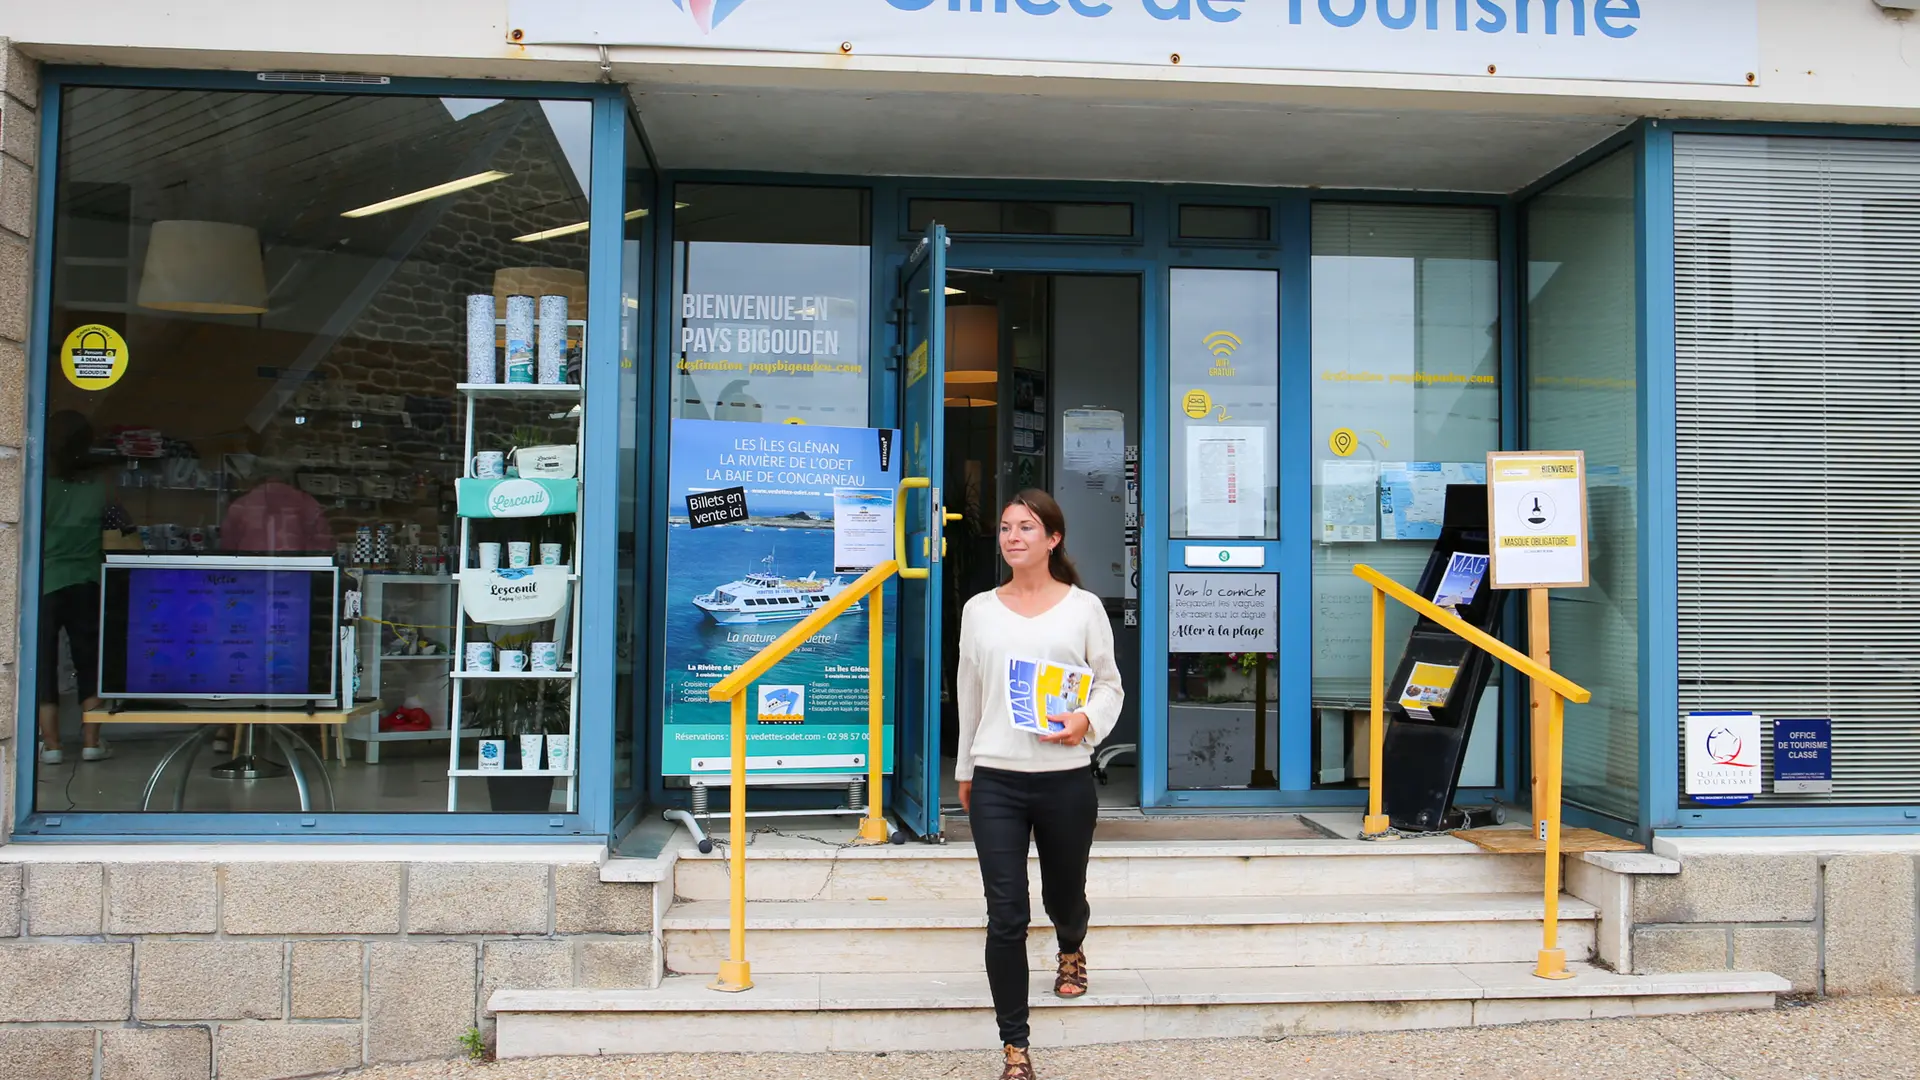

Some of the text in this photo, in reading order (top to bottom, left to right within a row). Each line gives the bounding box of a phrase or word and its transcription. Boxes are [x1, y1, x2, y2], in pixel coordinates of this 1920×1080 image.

[682, 293, 828, 321] BIENVENUE EN
[681, 327, 838, 355] PAYS BIGOUDEN
[1208, 367, 1236, 377] GRATUIT
[734, 436, 839, 454] LES ÎLES GLÉNAN
[720, 452, 854, 471] LA RIVIÈRE DE L'ODET
[1541, 464, 1574, 474] BIENVENUE
[706, 469, 865, 487] LA BAIE DE CONCARNEAU
[491, 490, 545, 512] Lesconil
[689, 492, 742, 511] Billets en
[694, 504, 743, 524] vente ici
[1504, 536, 1569, 547] MASQUE OBLIGATOIRE
[490, 581, 538, 596] Lesconil
[1174, 580, 1266, 597] Voir la corniche
[1175, 598, 1265, 610] Regarder les vagues
[1214, 610, 1228, 619] sur
[1230, 609, 1239, 619] la
[1240, 609, 1266, 621] digue
[726, 631, 740, 643] La
[742, 633, 777, 643] nature
[1171, 624, 1265, 640] Aller à la plage
[697, 663, 724, 671] Rivière
[824, 664, 869, 673] Les Îles Gléna
[683, 695, 708, 703] Croisière
[675, 732, 724, 741] Réservations
[827, 732, 837, 741] 02
[838, 732, 848, 741] 98
[850, 732, 860, 741] 57
[1789, 731, 1816, 740] OFFICE
[1778, 741, 1828, 750] DE TOURISME
[1788, 750, 1818, 759] CLASSÉ
[1696, 769, 1753, 779] QUALITÉ
[1697, 778, 1753, 786] TOURISME
